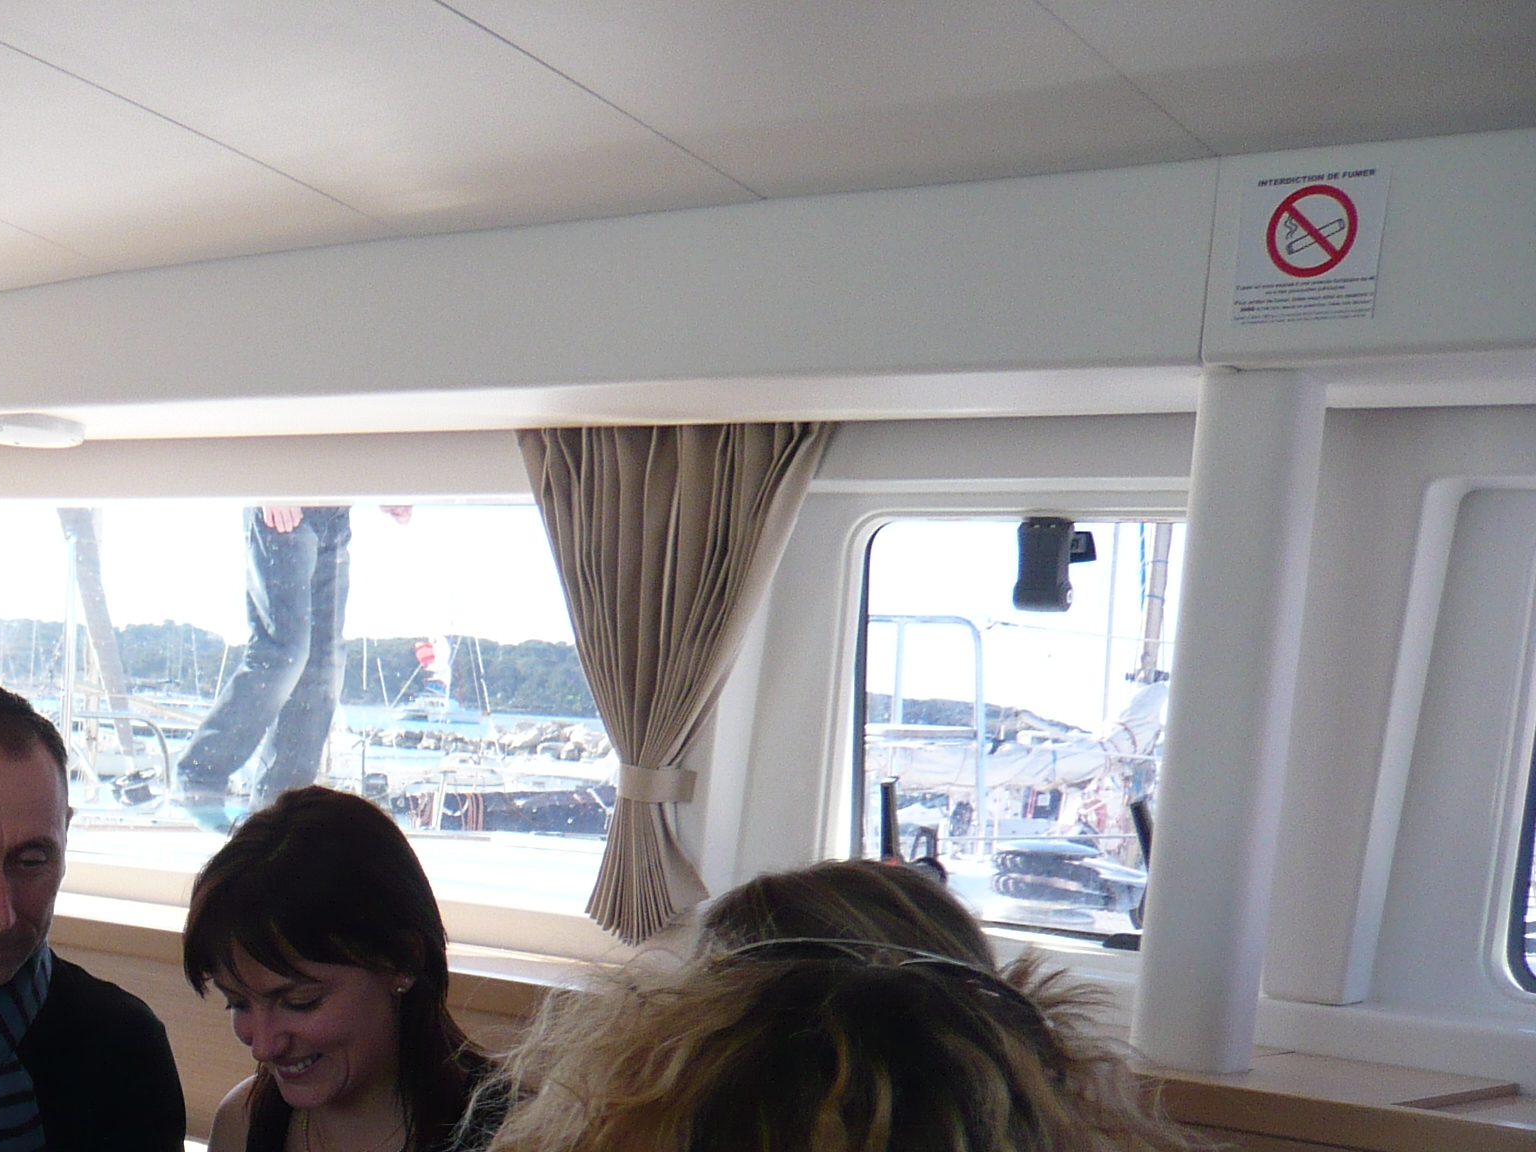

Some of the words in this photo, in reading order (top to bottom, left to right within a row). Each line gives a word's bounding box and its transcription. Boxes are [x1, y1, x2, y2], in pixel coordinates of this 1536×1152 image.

[1258, 174, 1324, 187] INTERDICTION
[1327, 172, 1340, 181] DE
[1342, 168, 1376, 179] FUMER
